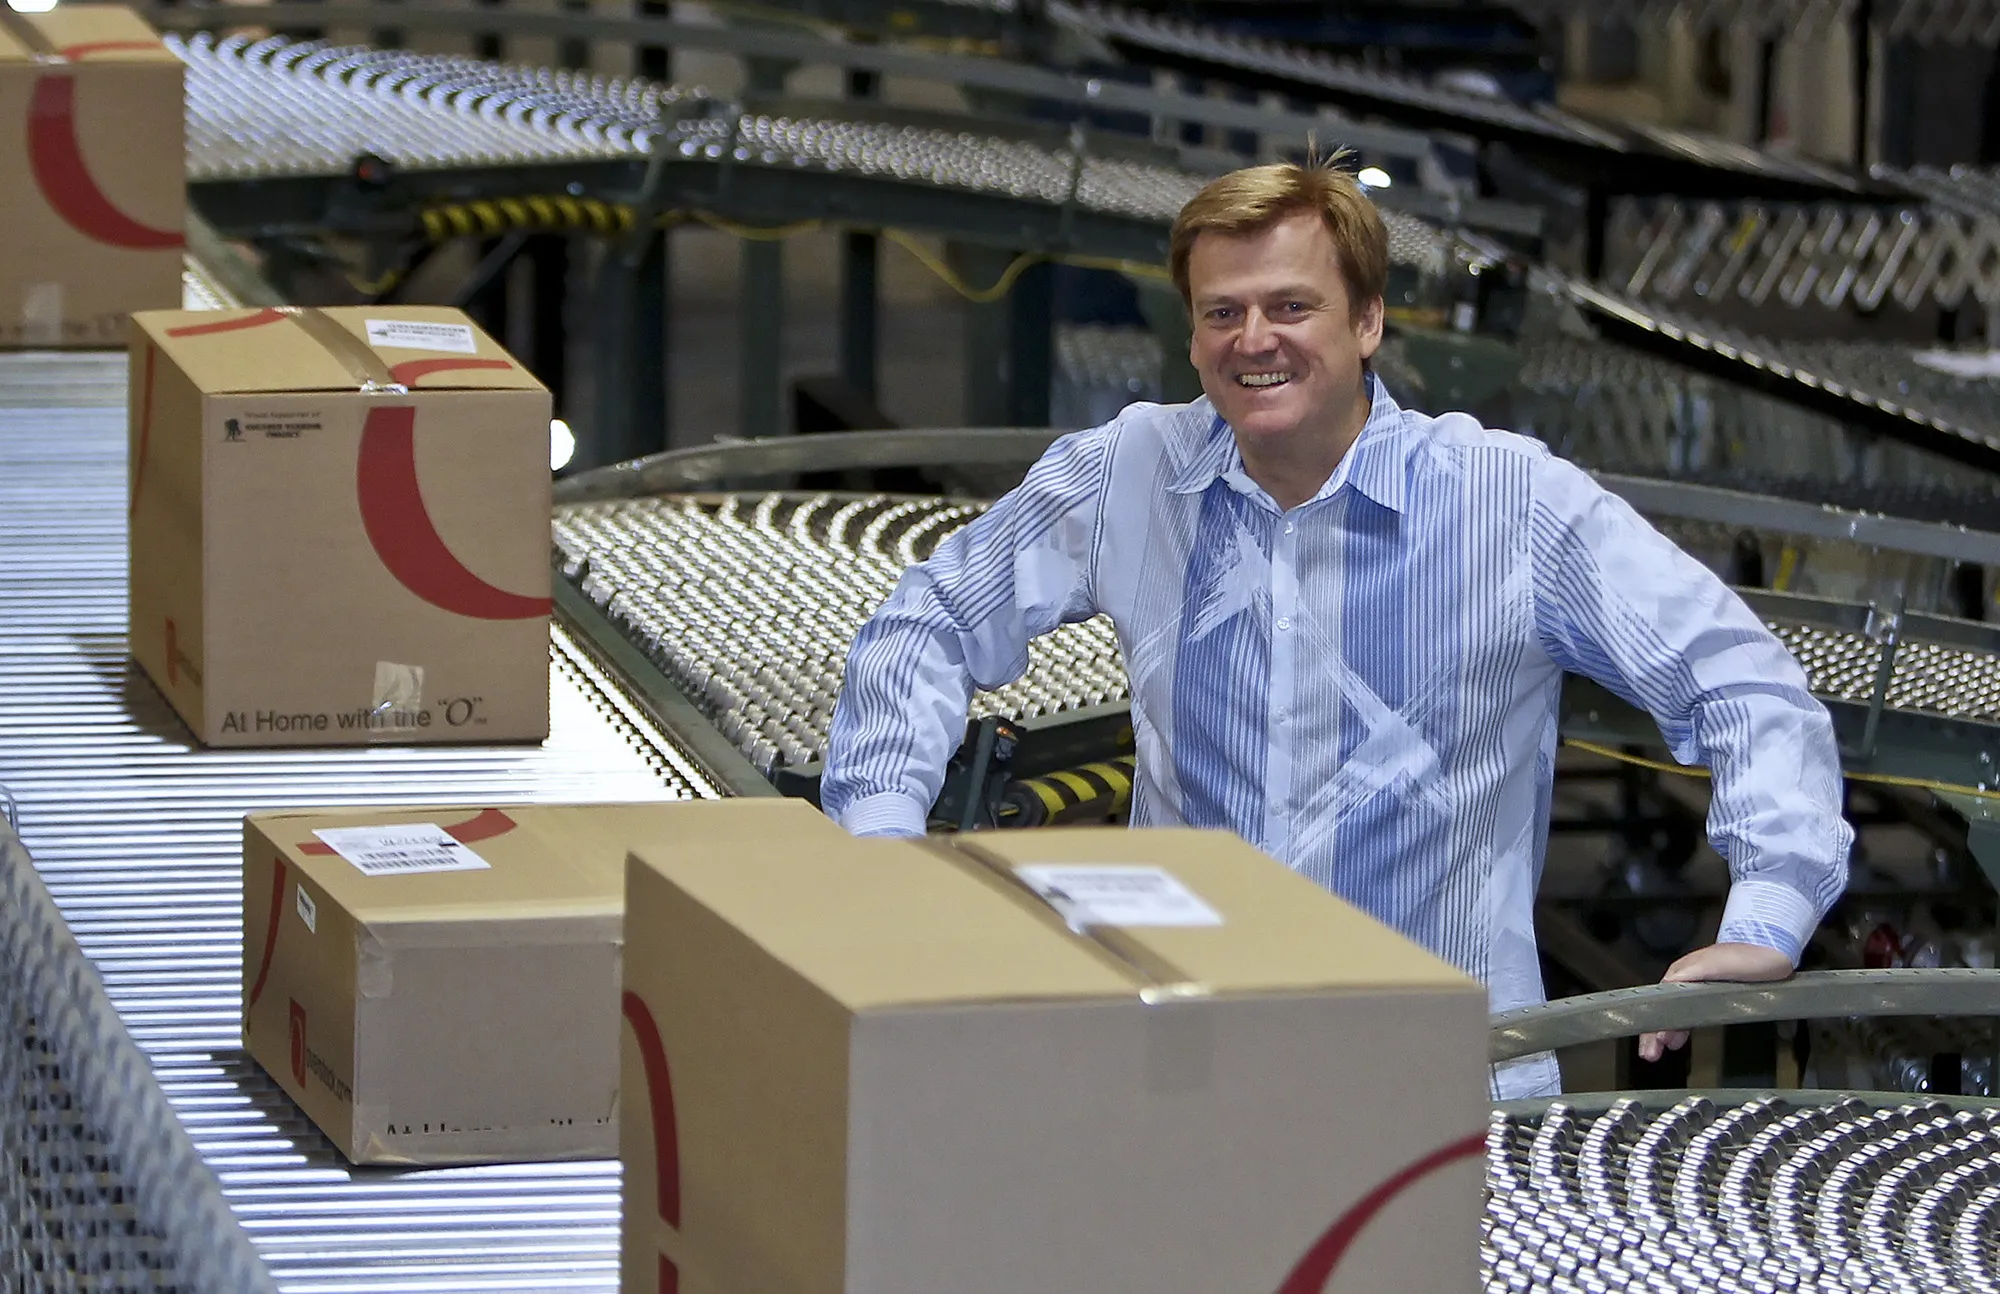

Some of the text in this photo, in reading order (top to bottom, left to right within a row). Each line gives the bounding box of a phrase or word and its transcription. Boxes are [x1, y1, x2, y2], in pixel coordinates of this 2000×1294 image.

[221, 711, 247, 733] At
[255, 709, 329, 732] Home
[336, 707, 384, 729] with
